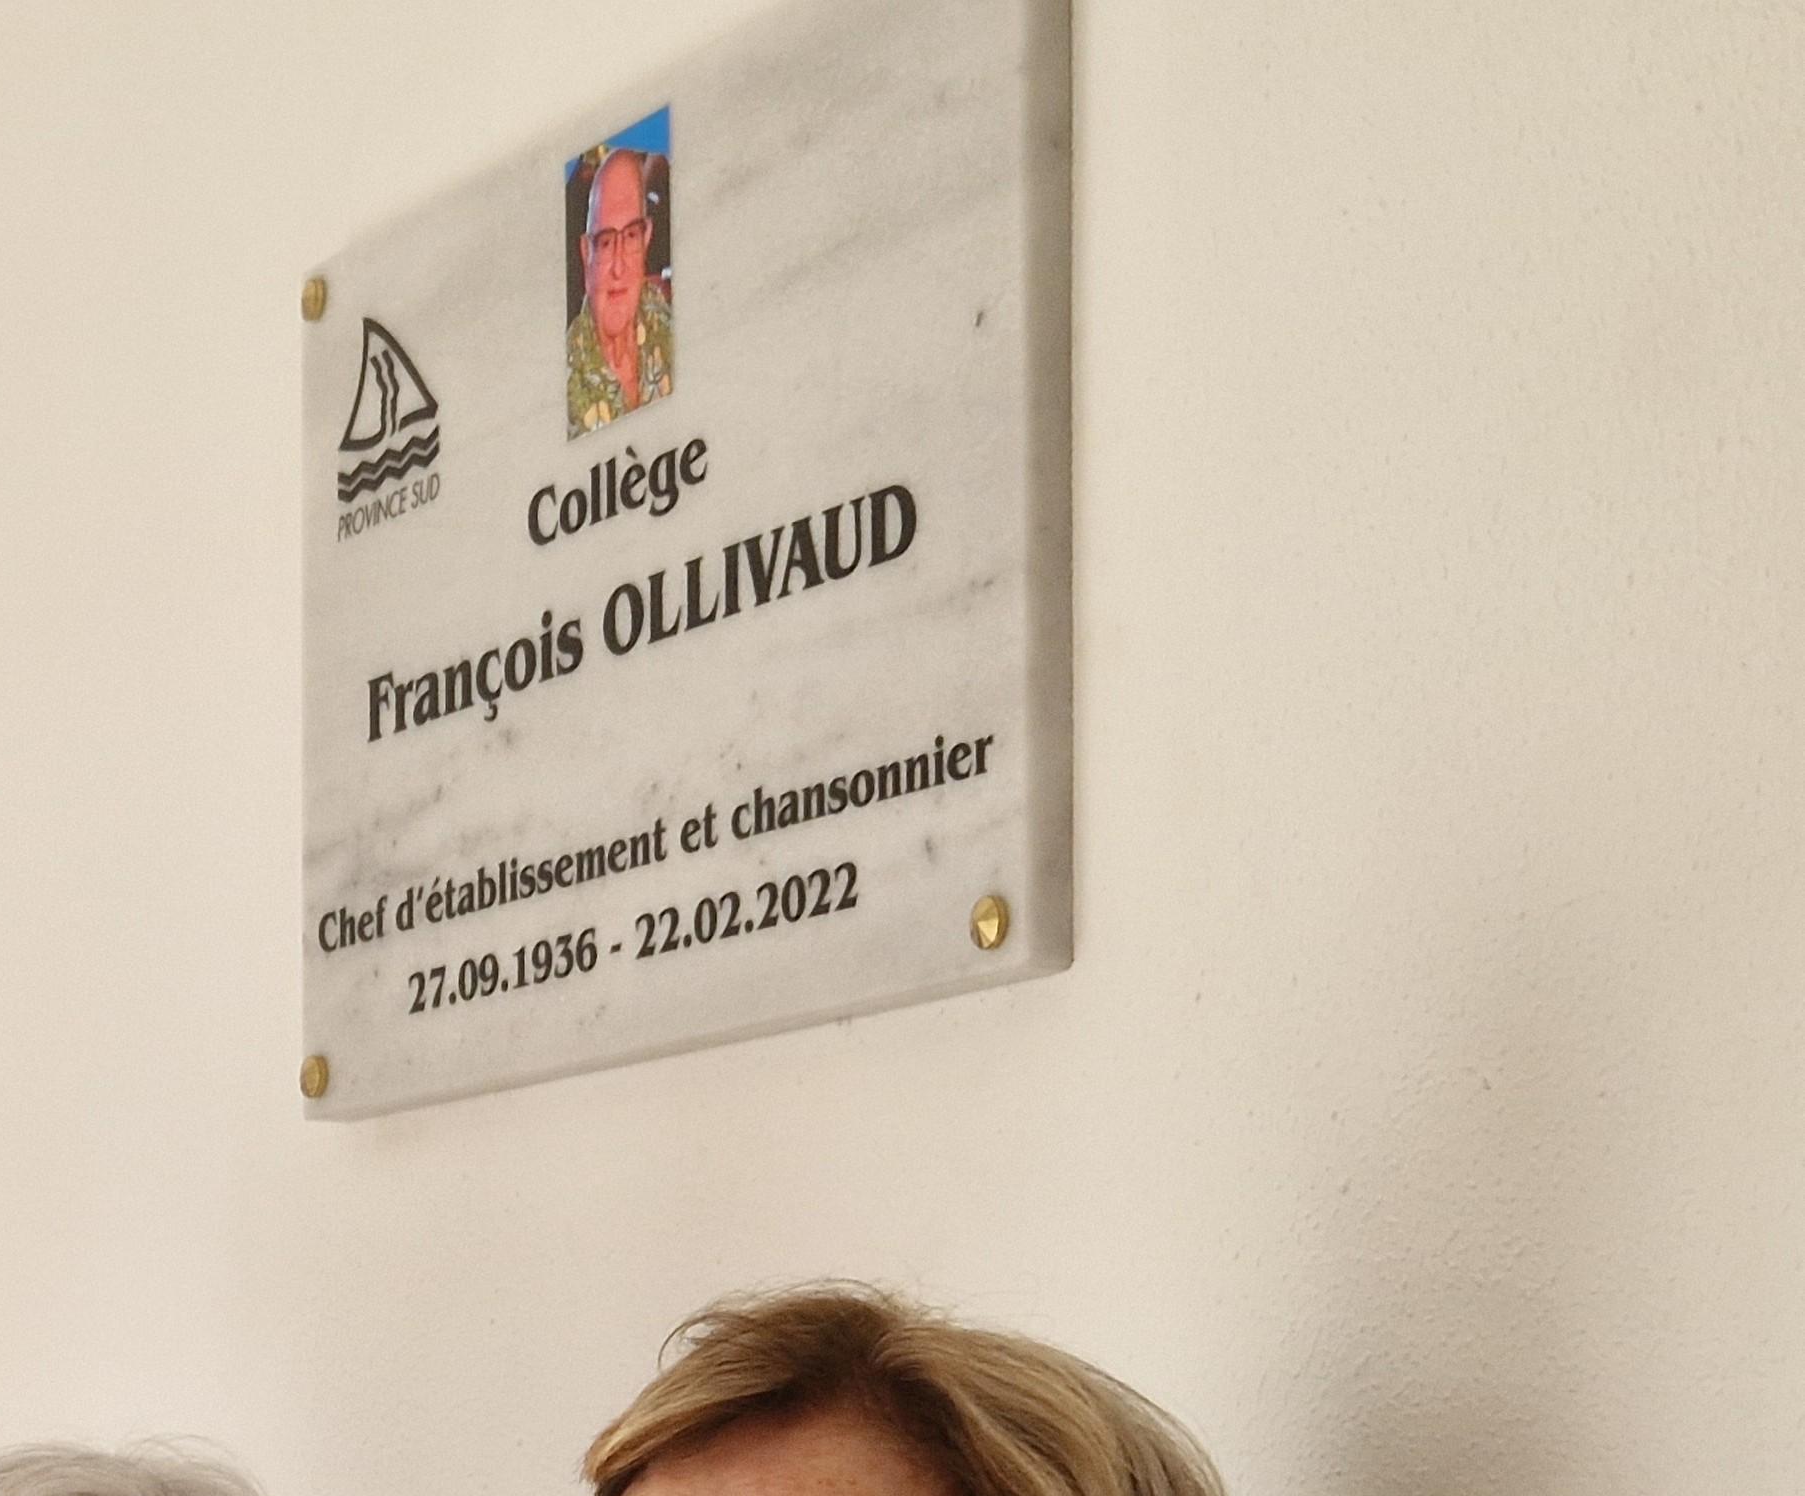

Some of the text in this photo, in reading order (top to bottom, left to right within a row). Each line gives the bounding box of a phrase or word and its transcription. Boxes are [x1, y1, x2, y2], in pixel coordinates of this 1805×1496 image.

[337, 472, 441, 543] PROVINCE SUD
[527, 437, 708, 546] Collège
[366, 484, 918, 743] François OLLIVAUD
[317, 734, 995, 953] Chef d'établissement et chansonnier
[407, 861, 860, 1015] 27.09.1936 - 22.02.2022
